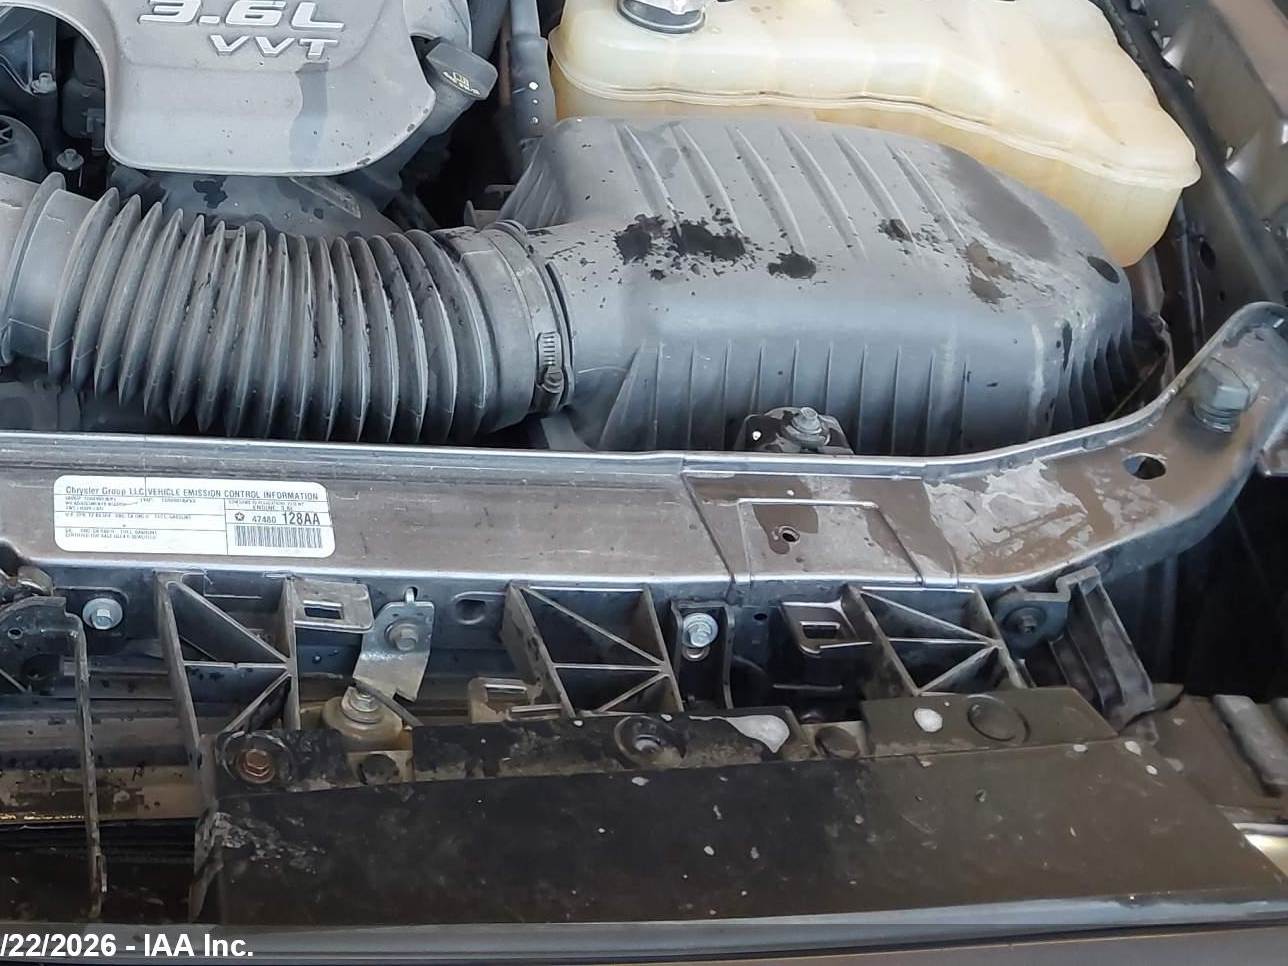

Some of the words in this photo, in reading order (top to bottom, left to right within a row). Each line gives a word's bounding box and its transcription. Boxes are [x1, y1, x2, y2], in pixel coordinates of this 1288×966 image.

[209, 34, 339, 59] VVT
[65, 485, 100, 496] Chrysler
[102, 486, 126, 496] Group
[147, 487, 180, 496] VEHICLE
[183, 488, 221, 497] EMISSION
[223, 489, 260, 498] CONTROL
[263, 491, 319, 500] INFORMATION
[281, 512, 320, 525] 128AA
